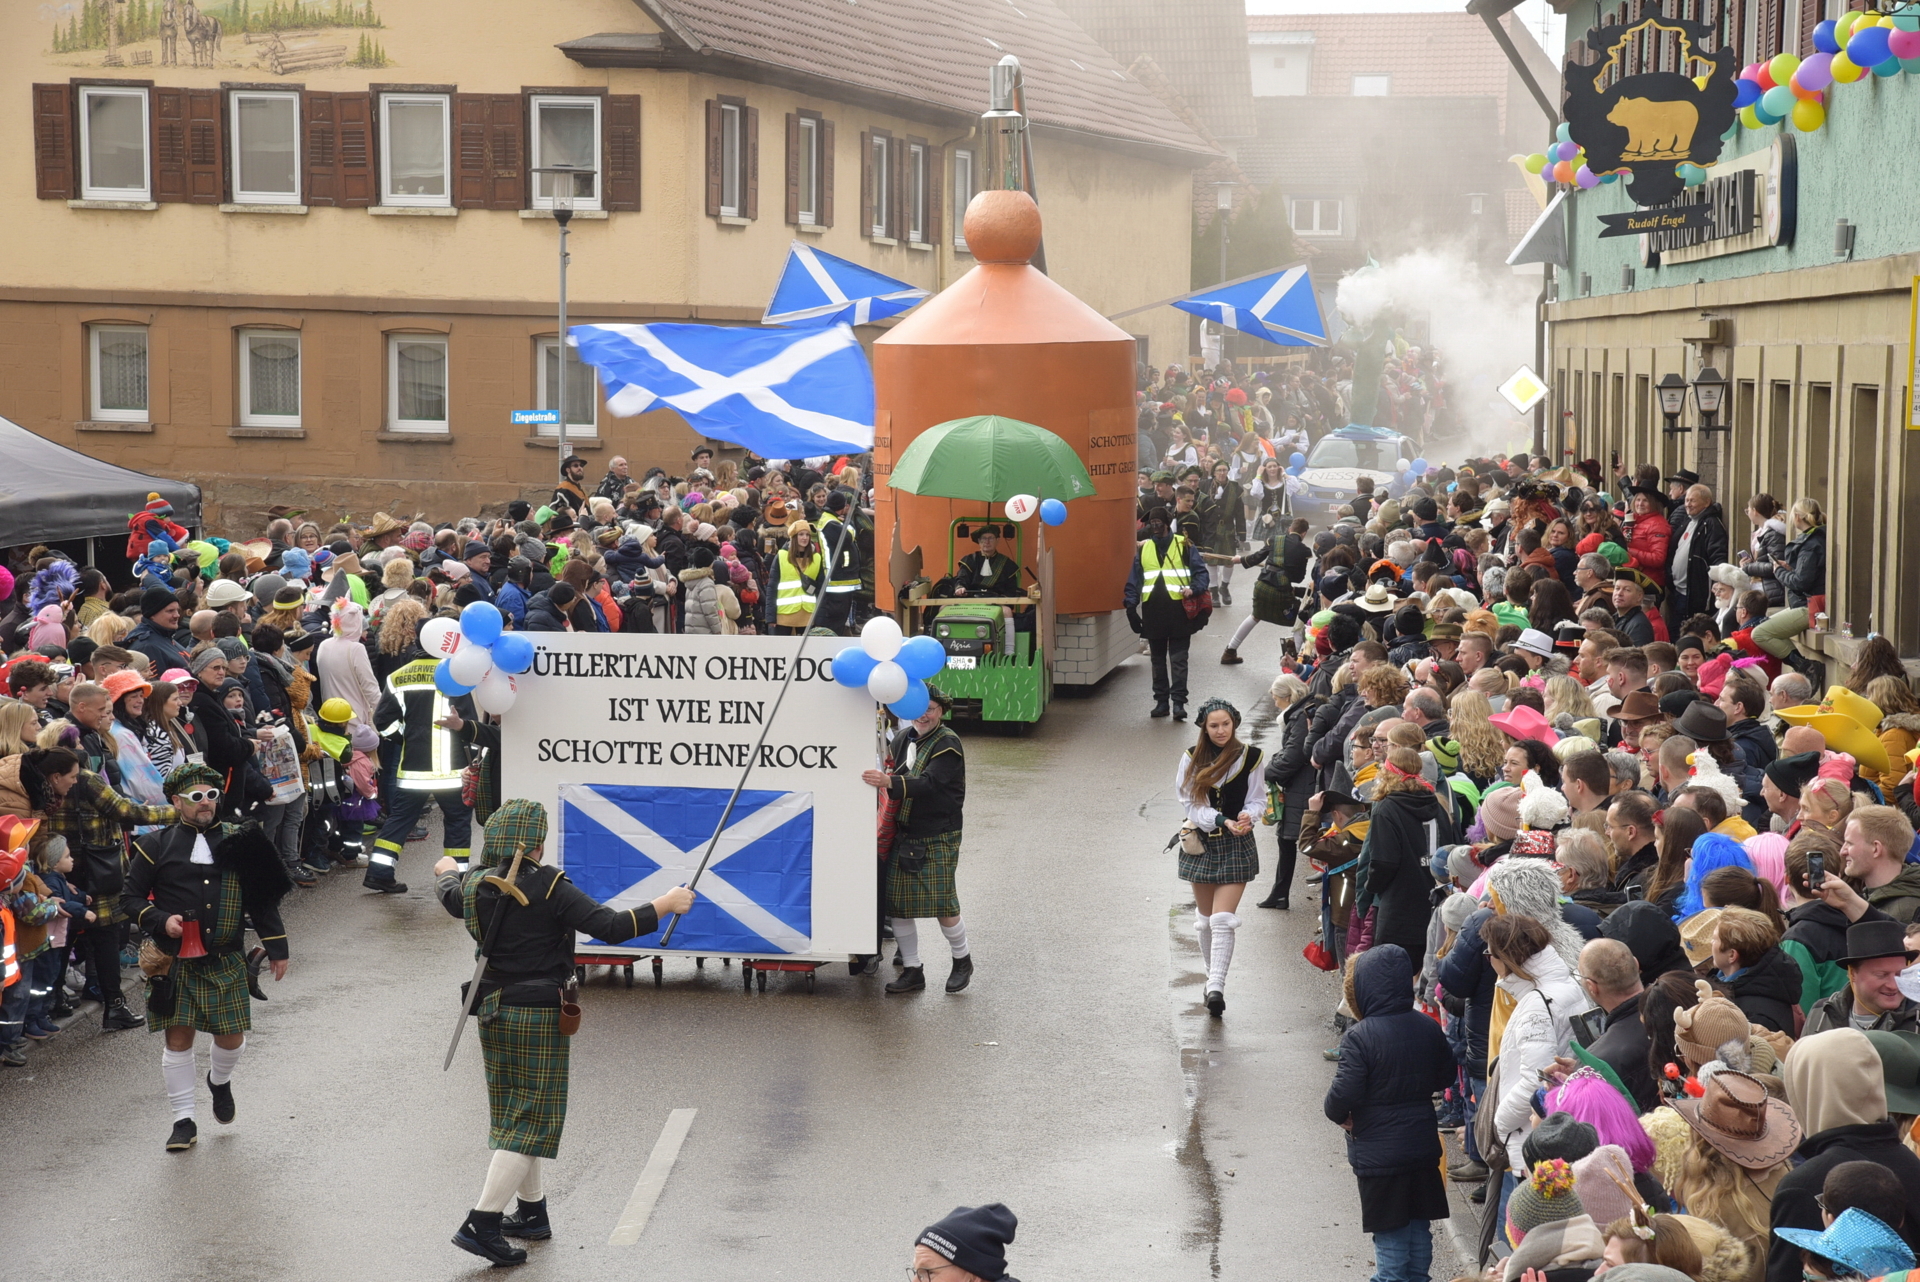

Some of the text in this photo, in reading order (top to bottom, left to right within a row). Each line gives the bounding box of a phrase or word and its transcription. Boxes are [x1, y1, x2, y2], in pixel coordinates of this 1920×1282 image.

[1627, 214, 1686, 230] Rudolf Engel
[514, 412, 557, 424] Ziegelstraße
[1090, 463, 1117, 476] HILFT
[440, 631, 454, 653] AVIA
[950, 640, 971, 651] Agria
[517, 646, 697, 681] ÜHLERTANN
[705, 656, 787, 682] OHNE
[608, 698, 765, 725] IST WIE EIN
[538, 738, 838, 769] SCHOTTE OHNE ROCK
[926, 1231, 957, 1252] FEUERWEHR
